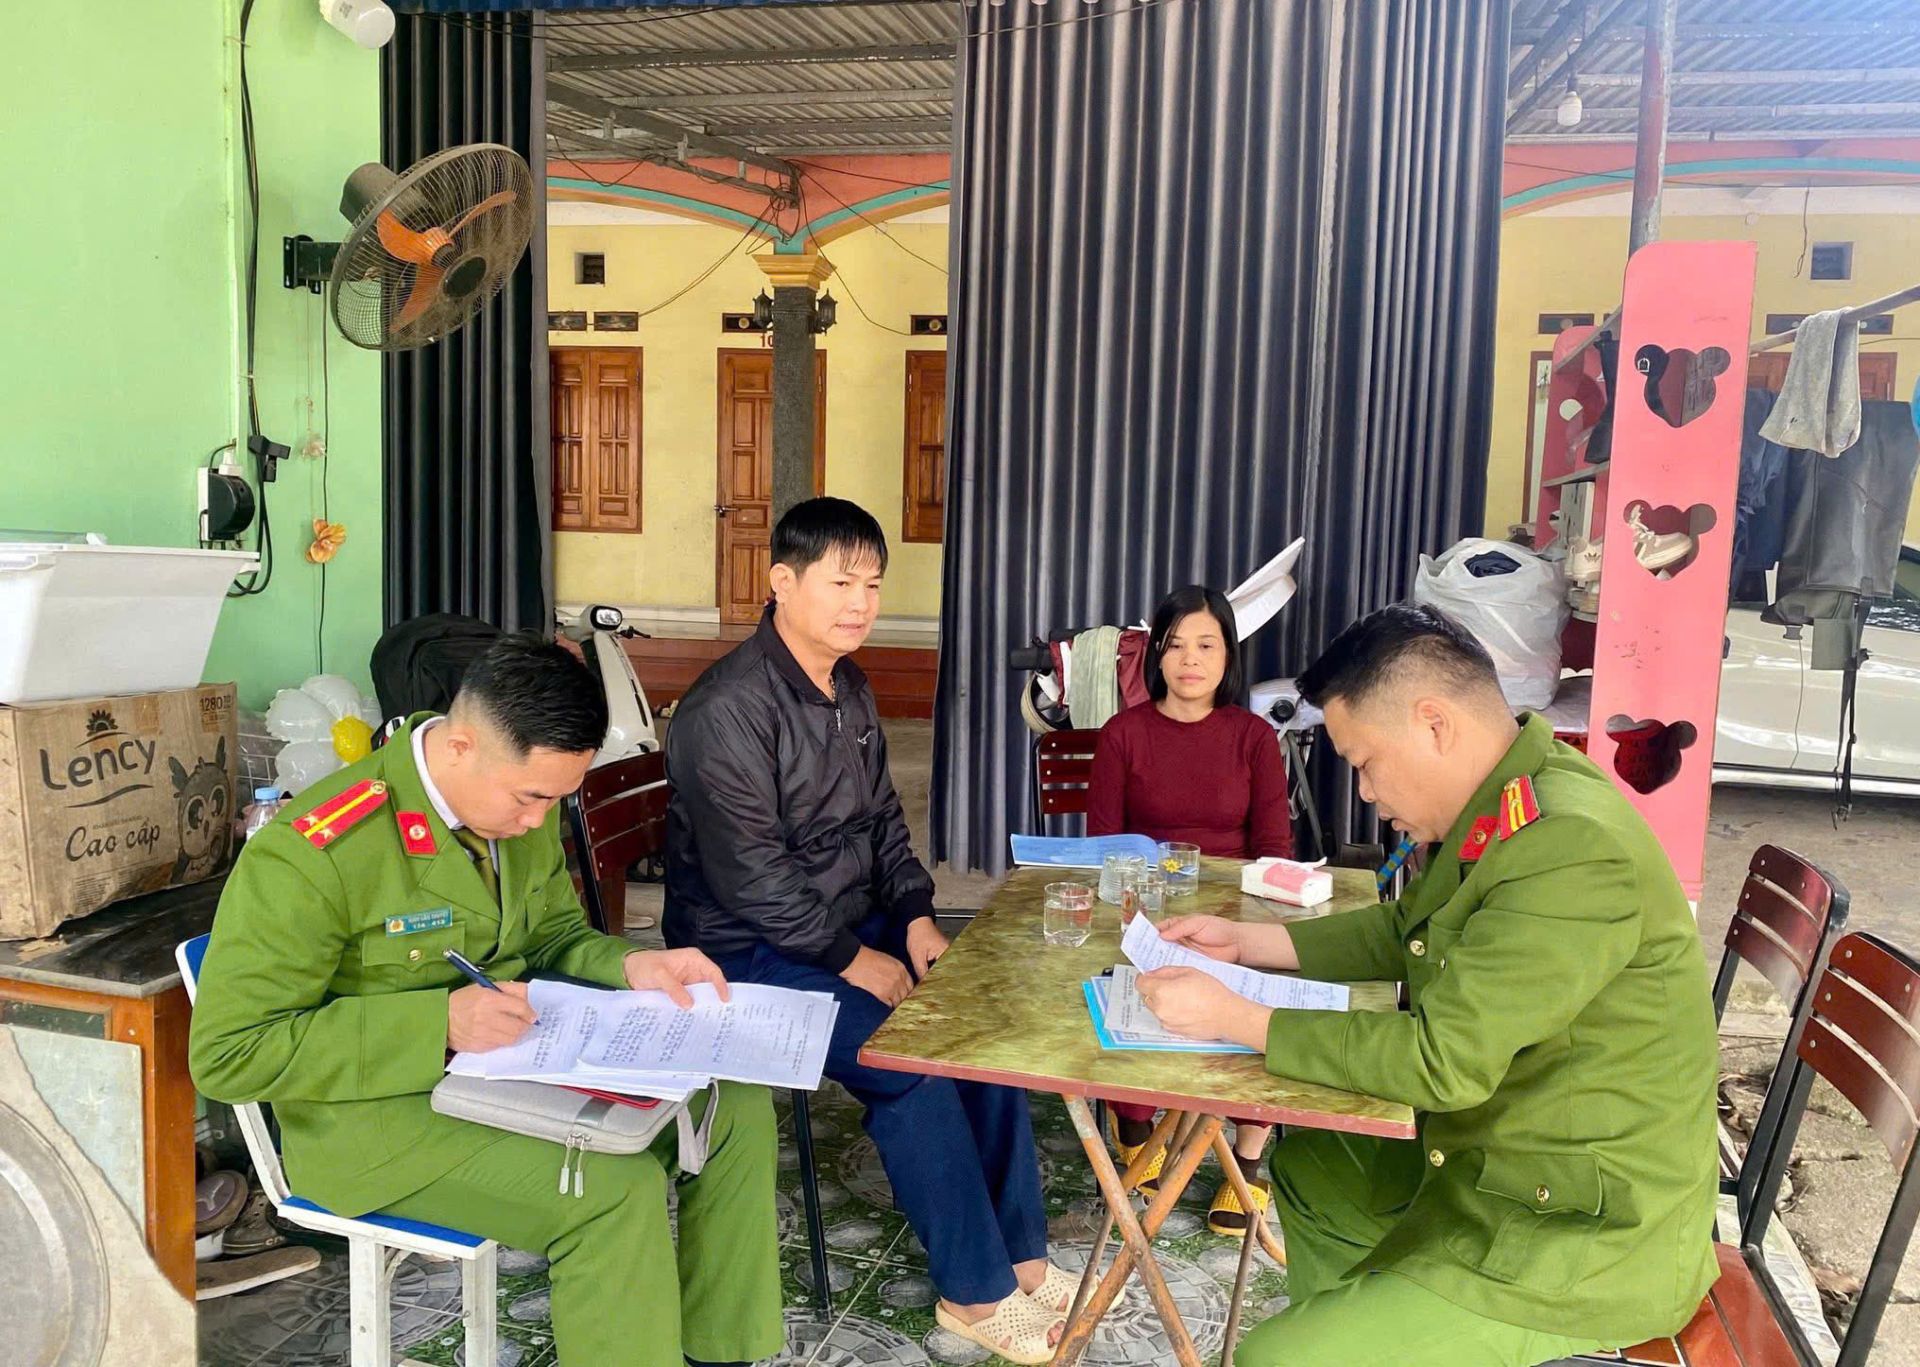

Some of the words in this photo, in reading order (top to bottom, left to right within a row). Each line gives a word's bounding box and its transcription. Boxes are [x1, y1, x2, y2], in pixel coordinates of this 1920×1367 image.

[200, 696, 223, 711] 1280
[40, 738, 156, 792] Lency
[65, 824, 118, 862] Cao
[125, 816, 161, 855] cấp
